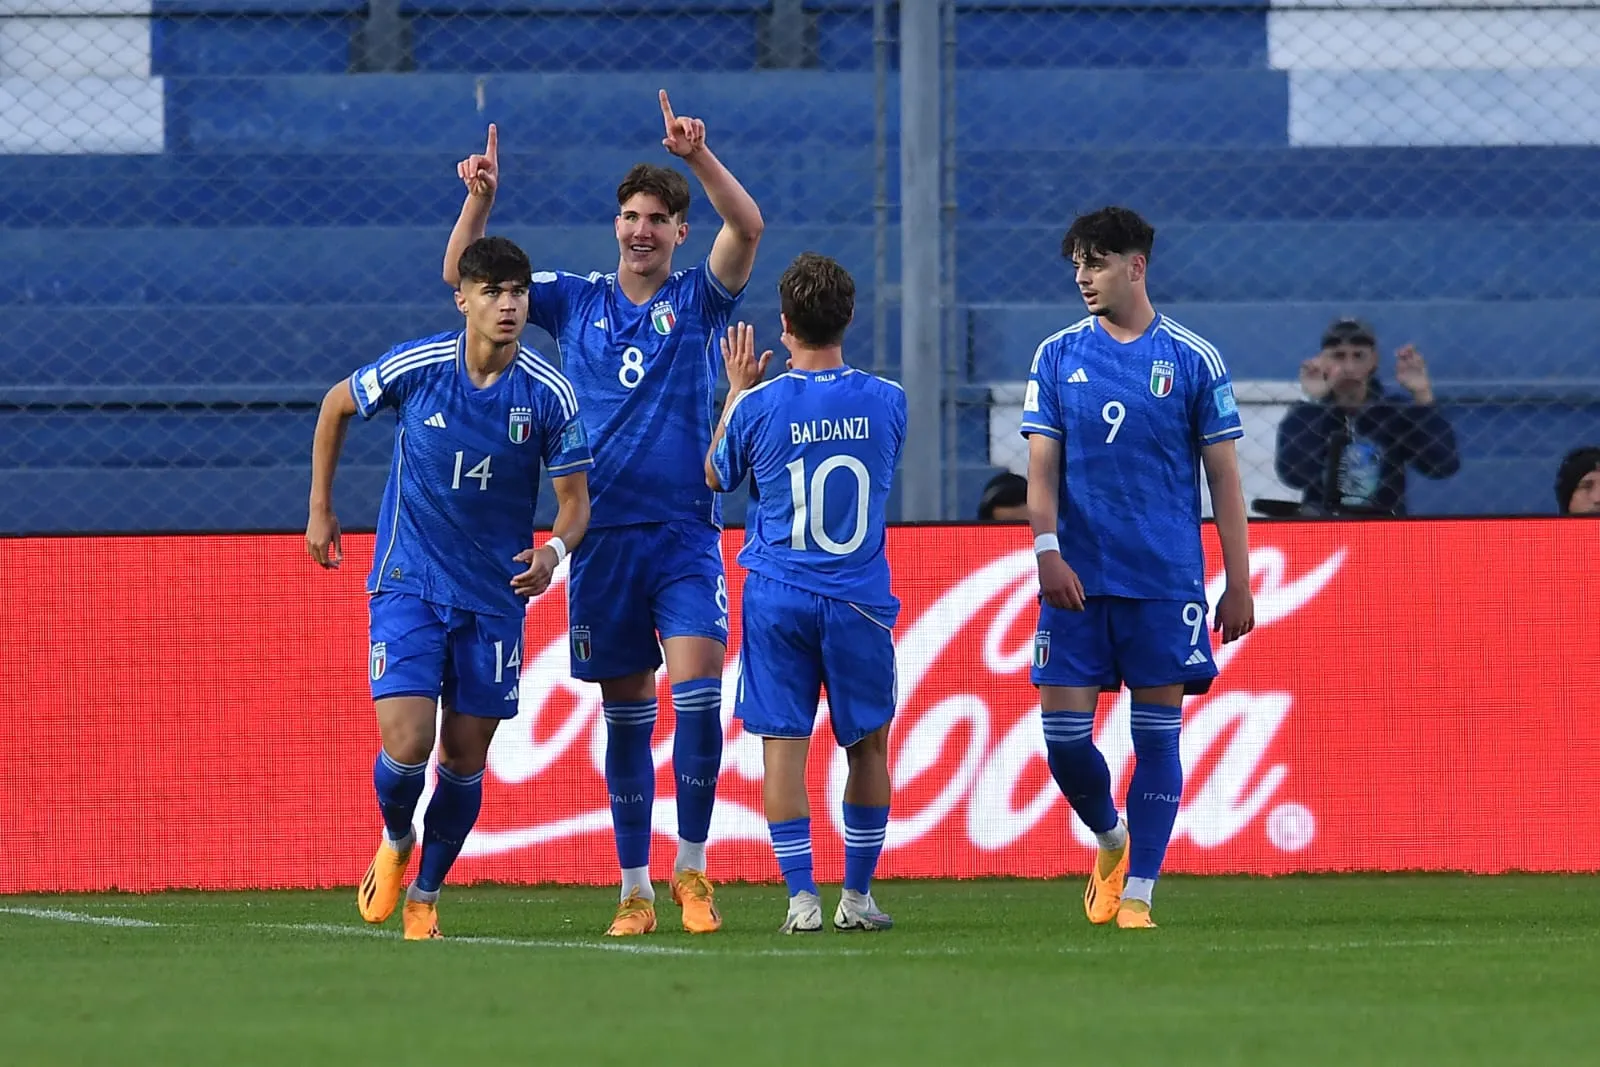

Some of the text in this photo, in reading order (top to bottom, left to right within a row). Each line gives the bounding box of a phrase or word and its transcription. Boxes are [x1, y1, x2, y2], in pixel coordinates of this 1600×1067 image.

[619, 346, 645, 389] 8
[815, 374, 836, 383] ITALIA
[1153, 367, 1171, 375] ITALIA
[790, 417, 870, 445] BALDANZI
[1102, 400, 1126, 444] 9
[451, 450, 493, 491] 14
[786, 454, 871, 555] 10
[715, 574, 728, 614] 8
[1182, 602, 1203, 647] 9
[494, 637, 522, 683] 14
[682, 773, 718, 788] ITALIA
